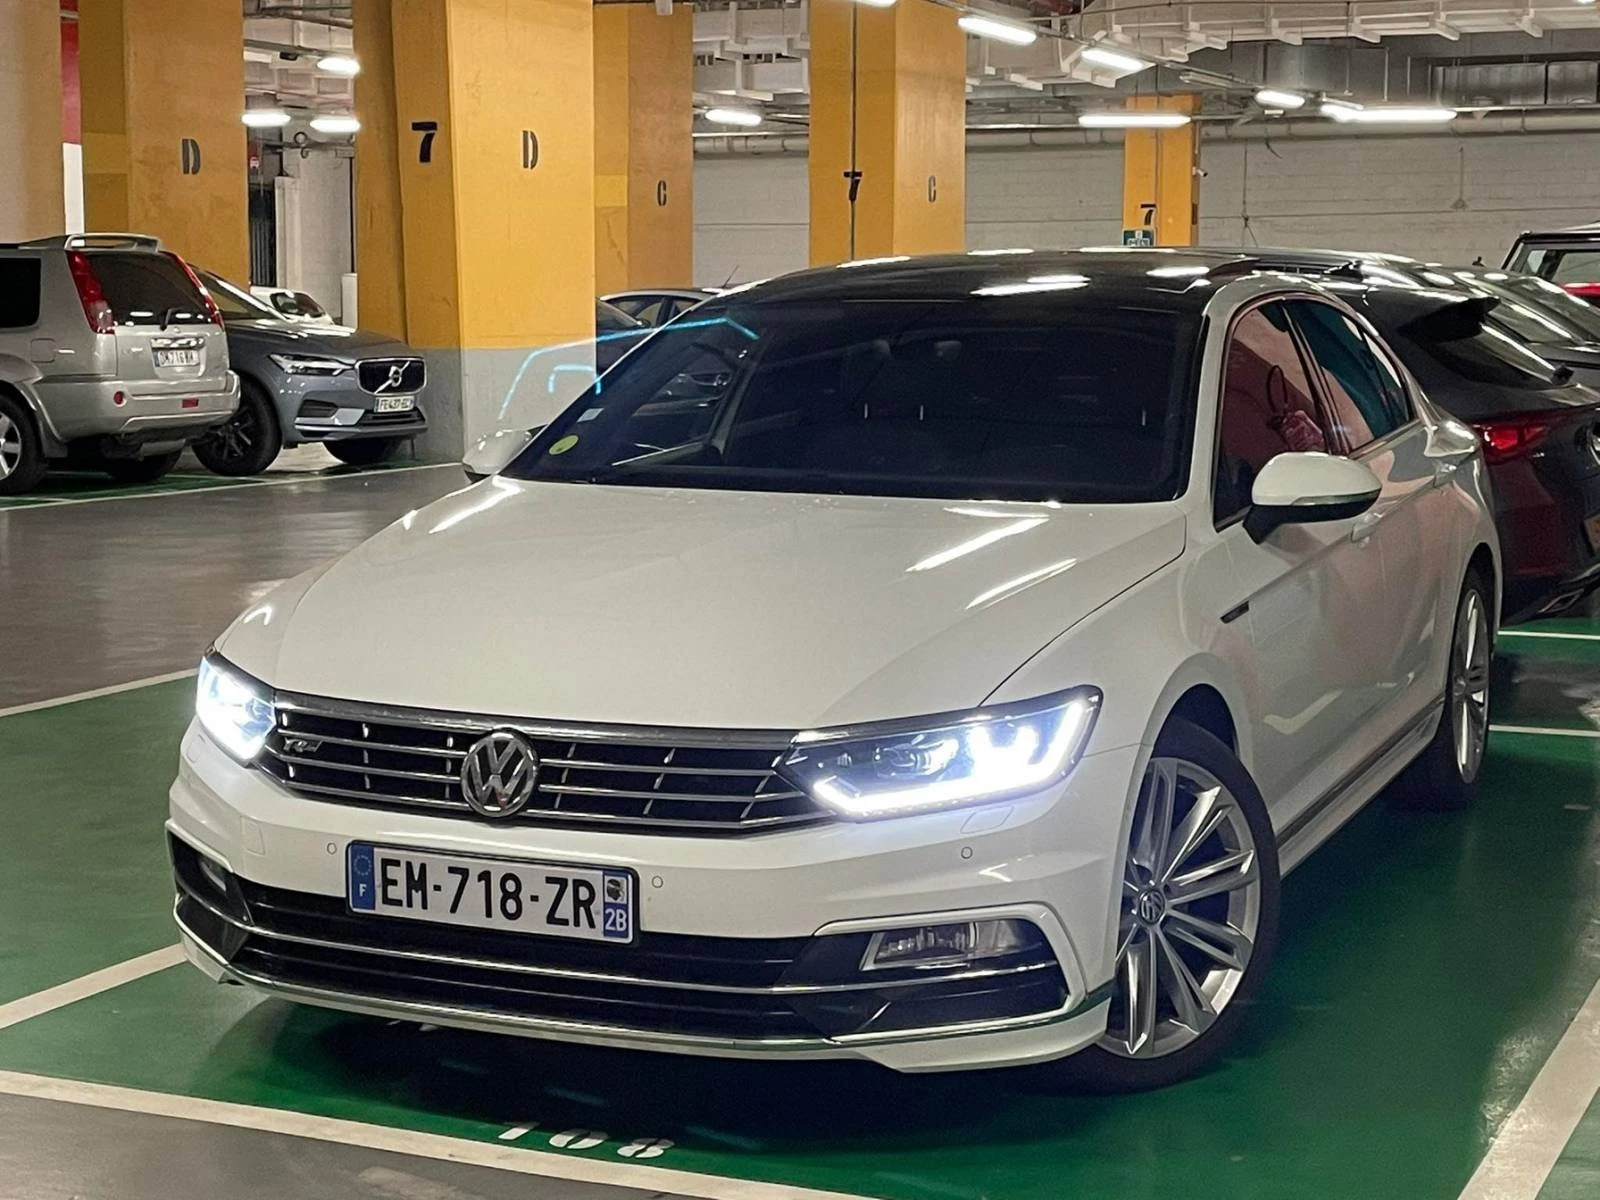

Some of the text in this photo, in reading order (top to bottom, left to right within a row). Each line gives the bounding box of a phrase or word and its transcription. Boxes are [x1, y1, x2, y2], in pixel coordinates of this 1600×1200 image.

[181, 138, 201, 175] D
[411, 121, 438, 163] 7
[523, 130, 539, 170] D
[657, 180, 667, 207] C
[843, 171, 863, 202] 7
[928, 175, 937, 203] C
[1140, 203, 1157, 226] 7
[461, 732, 538, 817] VW
[359, 857, 628, 932] F EM-718-ZR 2B
